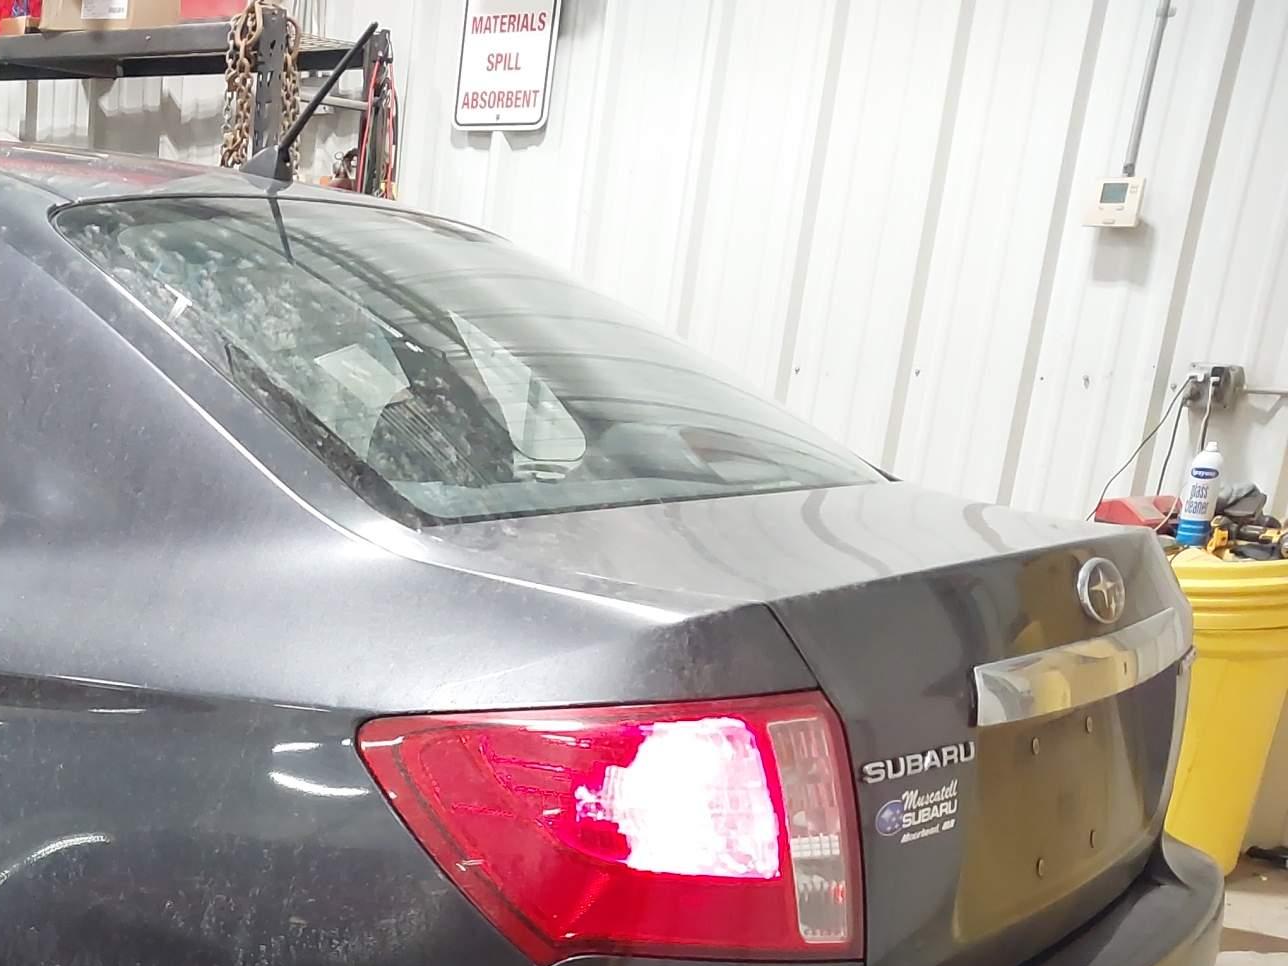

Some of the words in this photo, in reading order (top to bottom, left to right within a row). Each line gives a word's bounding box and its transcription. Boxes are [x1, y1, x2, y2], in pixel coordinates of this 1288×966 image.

[471, 12, 547, 34] MATERIALS
[486, 52, 521, 72] SPILL
[461, 90, 540, 109] ABSORBENT
[862, 741, 976, 784] SUBARU
[901, 779, 958, 811] Muscatell
[902, 799, 958, 829] SUBARU
